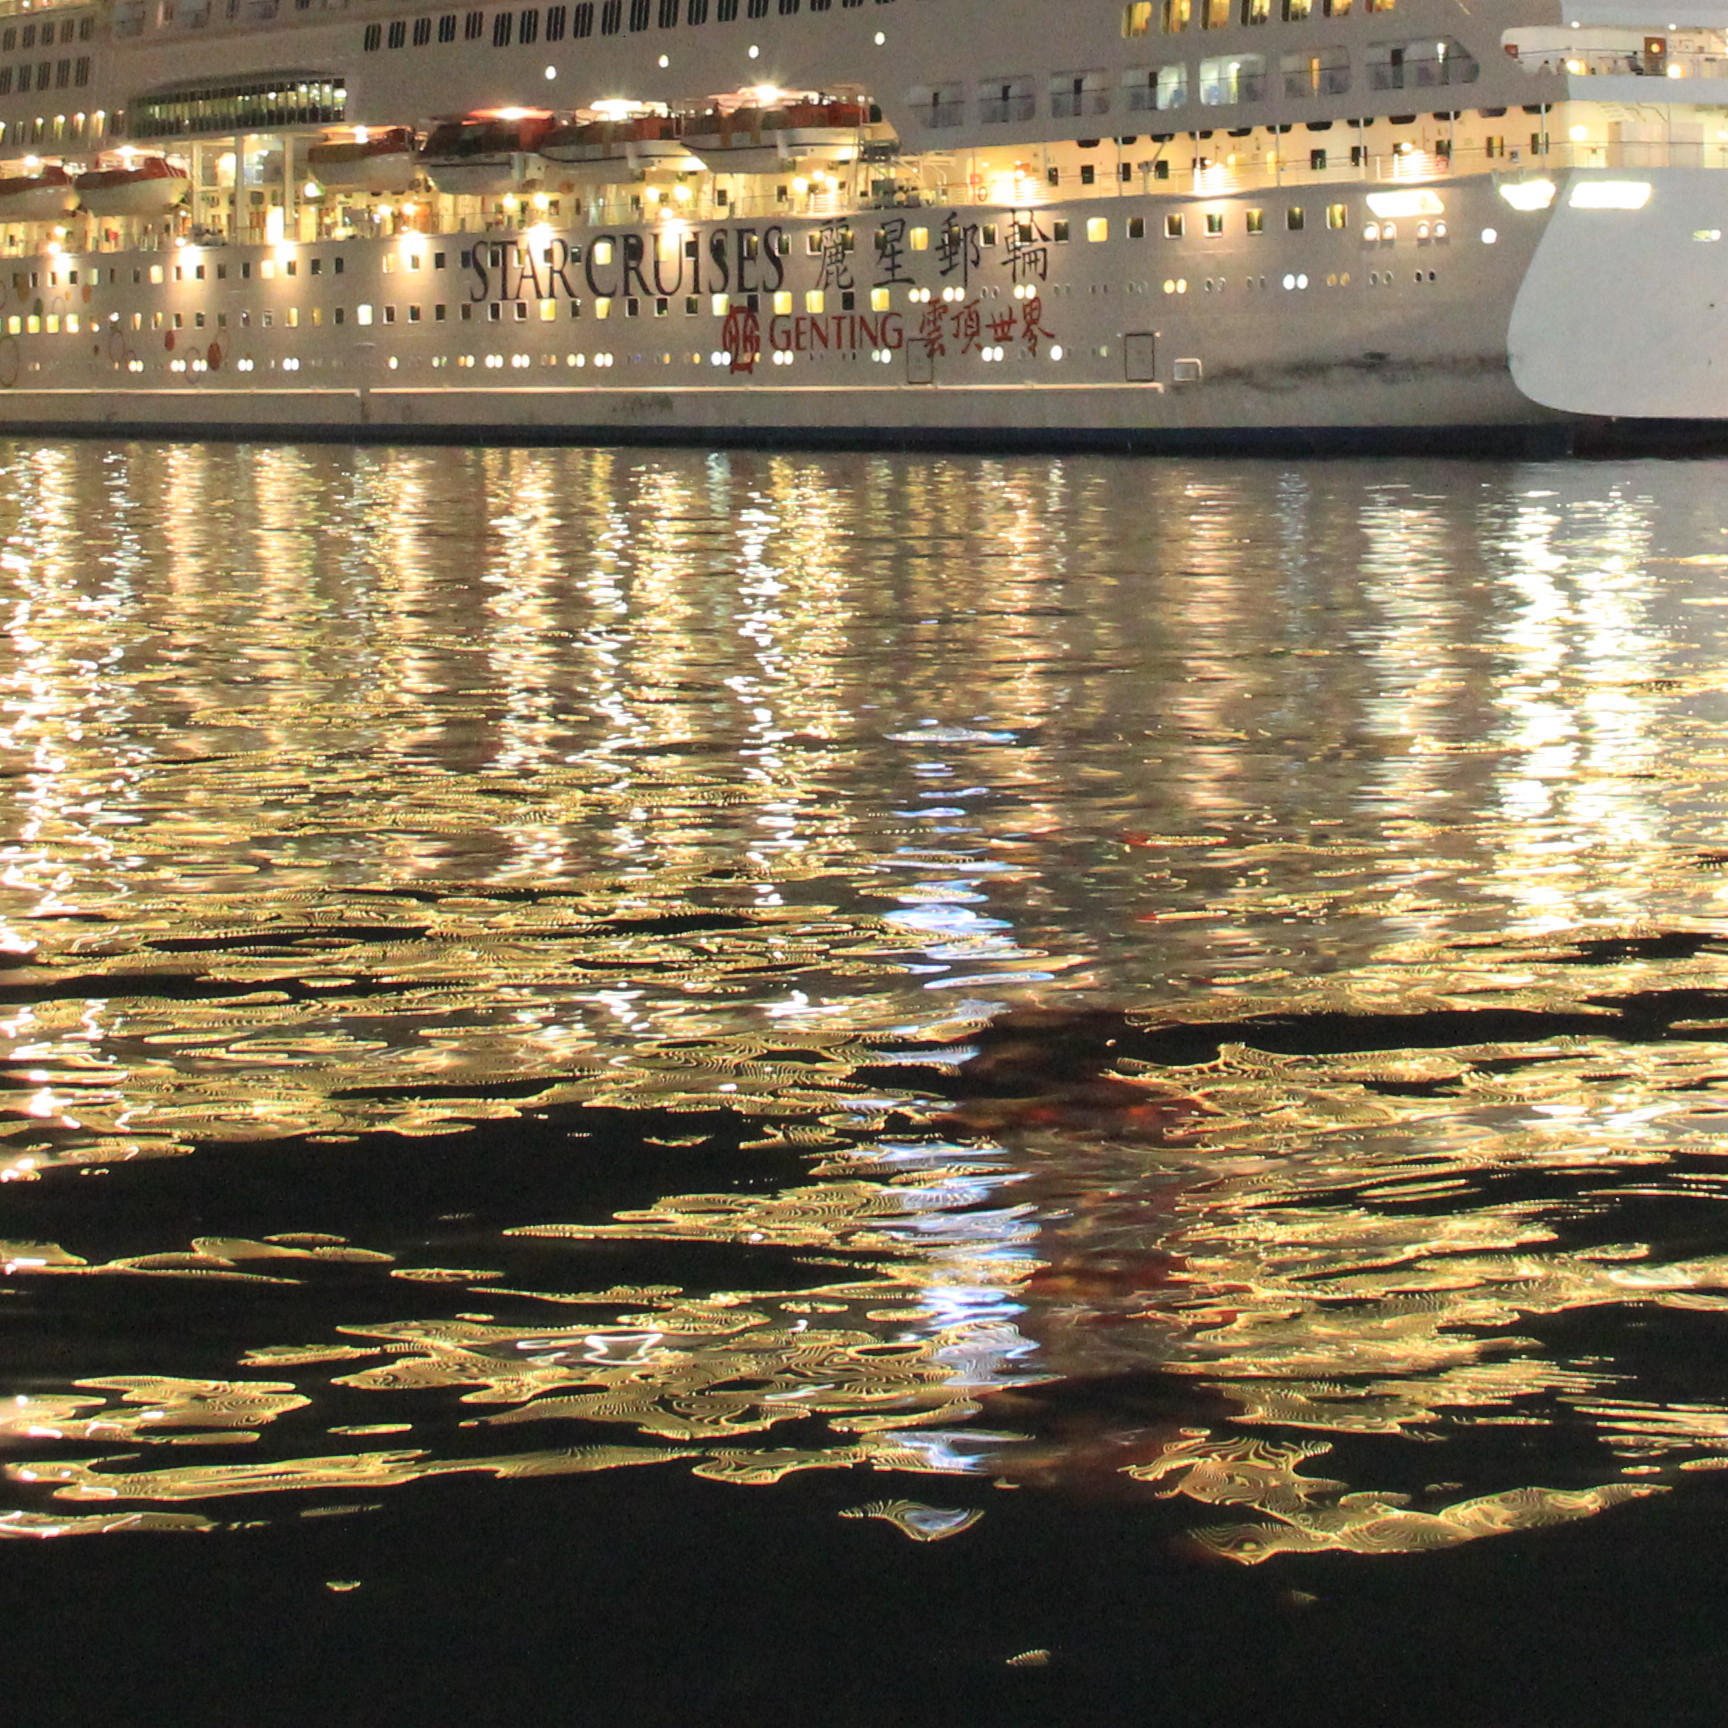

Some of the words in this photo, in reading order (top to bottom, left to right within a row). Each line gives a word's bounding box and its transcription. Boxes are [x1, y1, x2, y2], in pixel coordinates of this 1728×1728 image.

[470, 238, 577, 302] STAR
[585, 226, 785, 297] CRUISES
[815, 208, 1053, 291] 麗星郵輪
[769, 312, 904, 352] GENTING
[918, 297, 1056, 359] 雲頂世界
